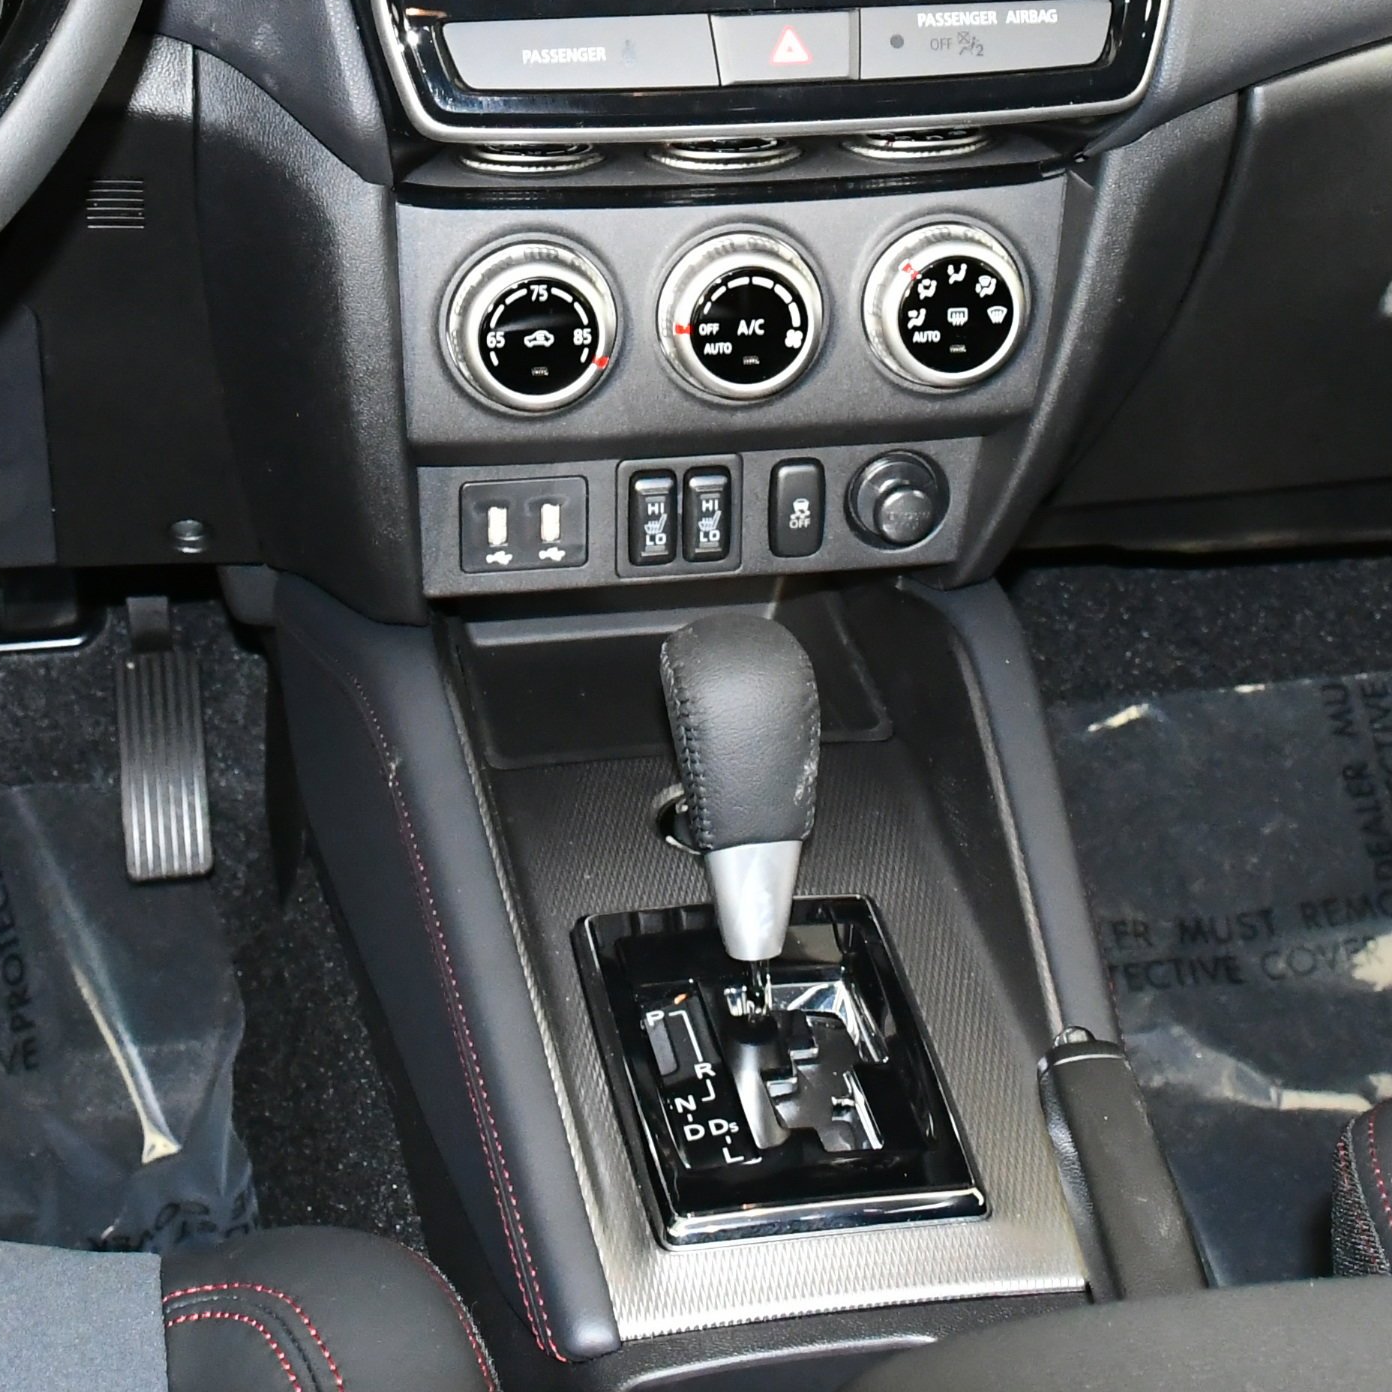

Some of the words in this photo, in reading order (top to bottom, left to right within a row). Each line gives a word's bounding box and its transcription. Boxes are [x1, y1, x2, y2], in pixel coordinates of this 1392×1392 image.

[917, 10, 997, 28] PASSENGER
[1006, 9, 1058, 24] AIRBAG
[930, 37, 952, 51] OFF
[522, 46, 606, 64] PASSENGER
[530, 285, 548, 302] 75
[699, 323, 719, 335] OFF
[737, 318, 765, 335] A/C
[486, 331, 505, 348] 65
[573, 328, 592, 346] 85
[913, 330, 941, 343] AUTO
[704, 342, 732, 355] AUTO
[647, 502, 665, 515] HI
[702, 499, 719, 512] HI
[789, 519, 811, 529] OFF
[646, 533, 666, 546] LO
[700, 530, 720, 542] LO
[1177, 909, 1276, 945] MUST
[646, 1010, 664, 1026] P
[694, 1063, 716, 1079] R
[674, 1095, 697, 1113] N
[683, 1124, 705, 1141] D
[722, 1147, 744, 1164] L
